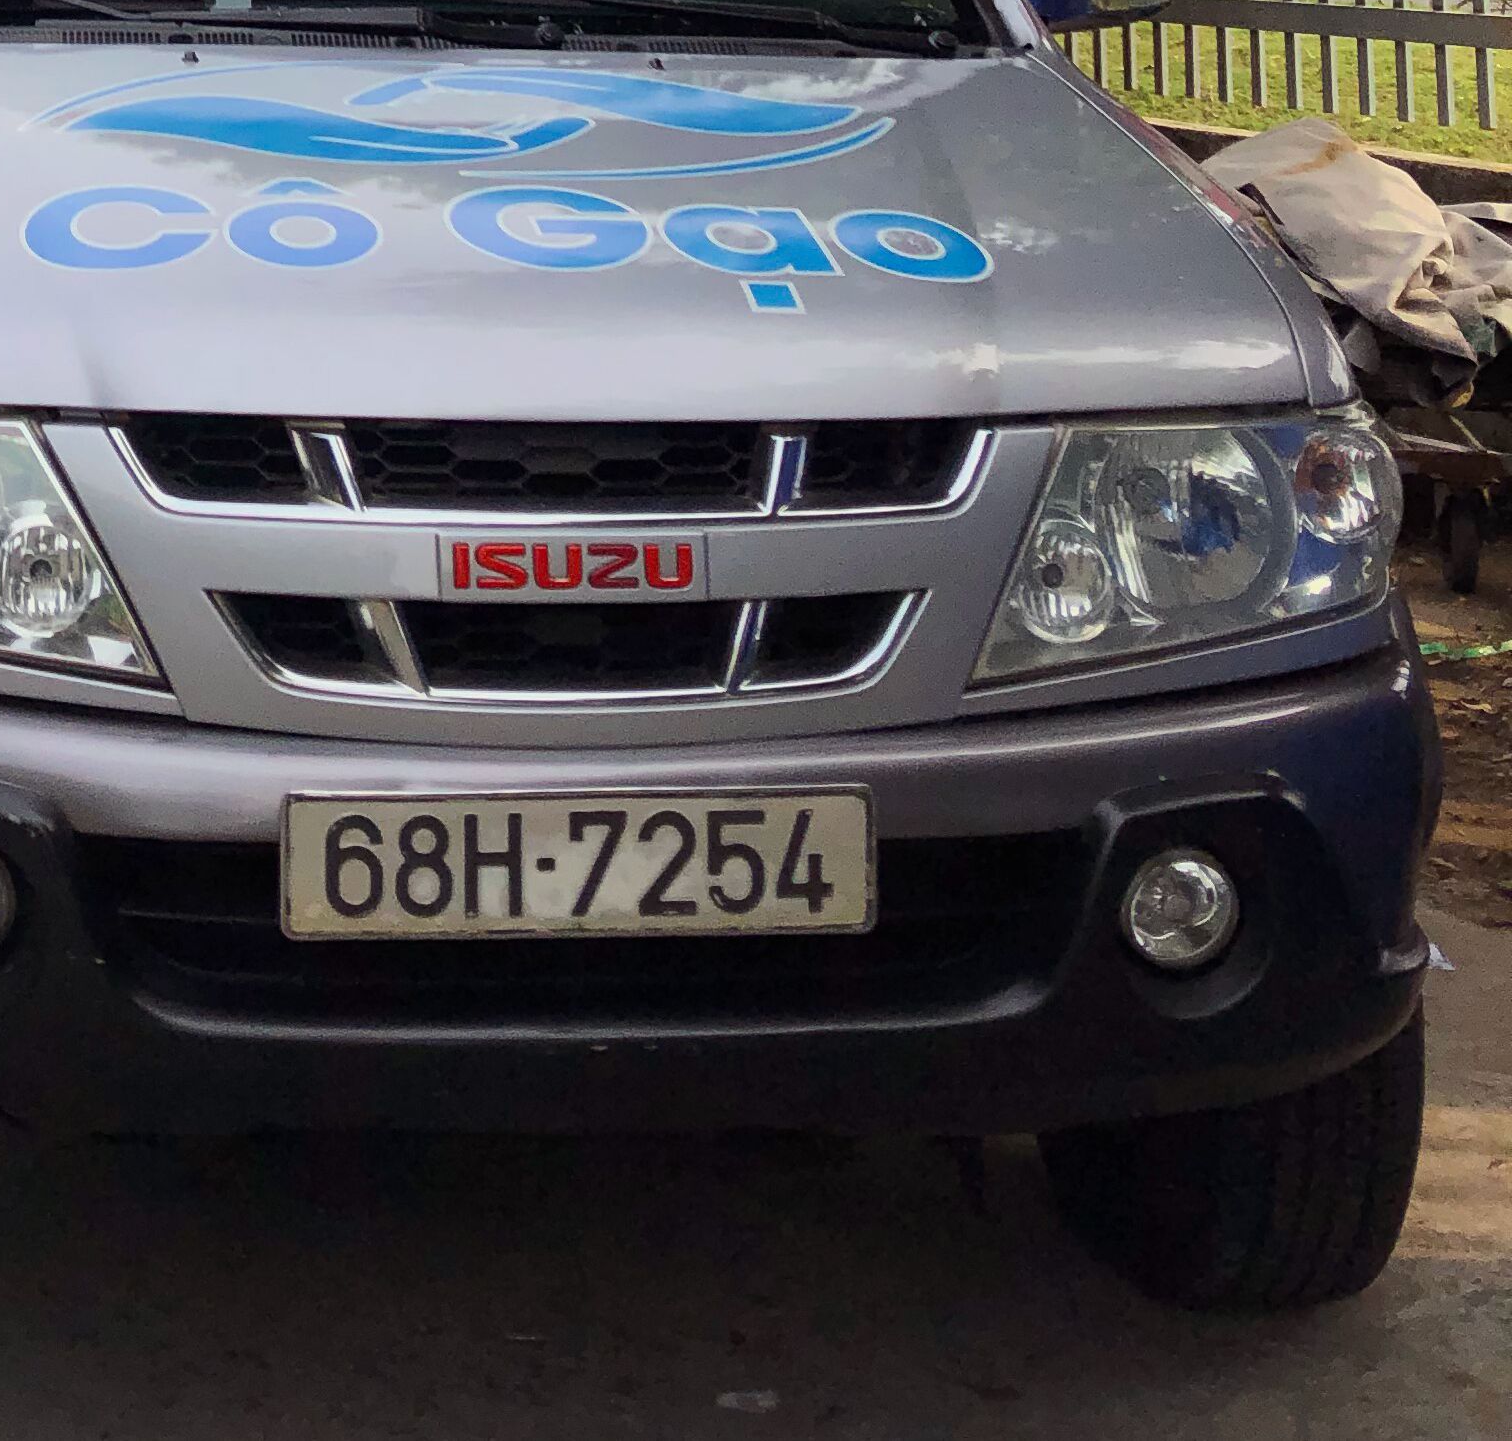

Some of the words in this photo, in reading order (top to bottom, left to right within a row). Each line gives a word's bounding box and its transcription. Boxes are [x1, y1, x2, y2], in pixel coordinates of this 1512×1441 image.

[19, 175, 384, 272] Cô
[443, 183, 995, 315] Gạo
[451, 541, 694, 591] ISUZU
